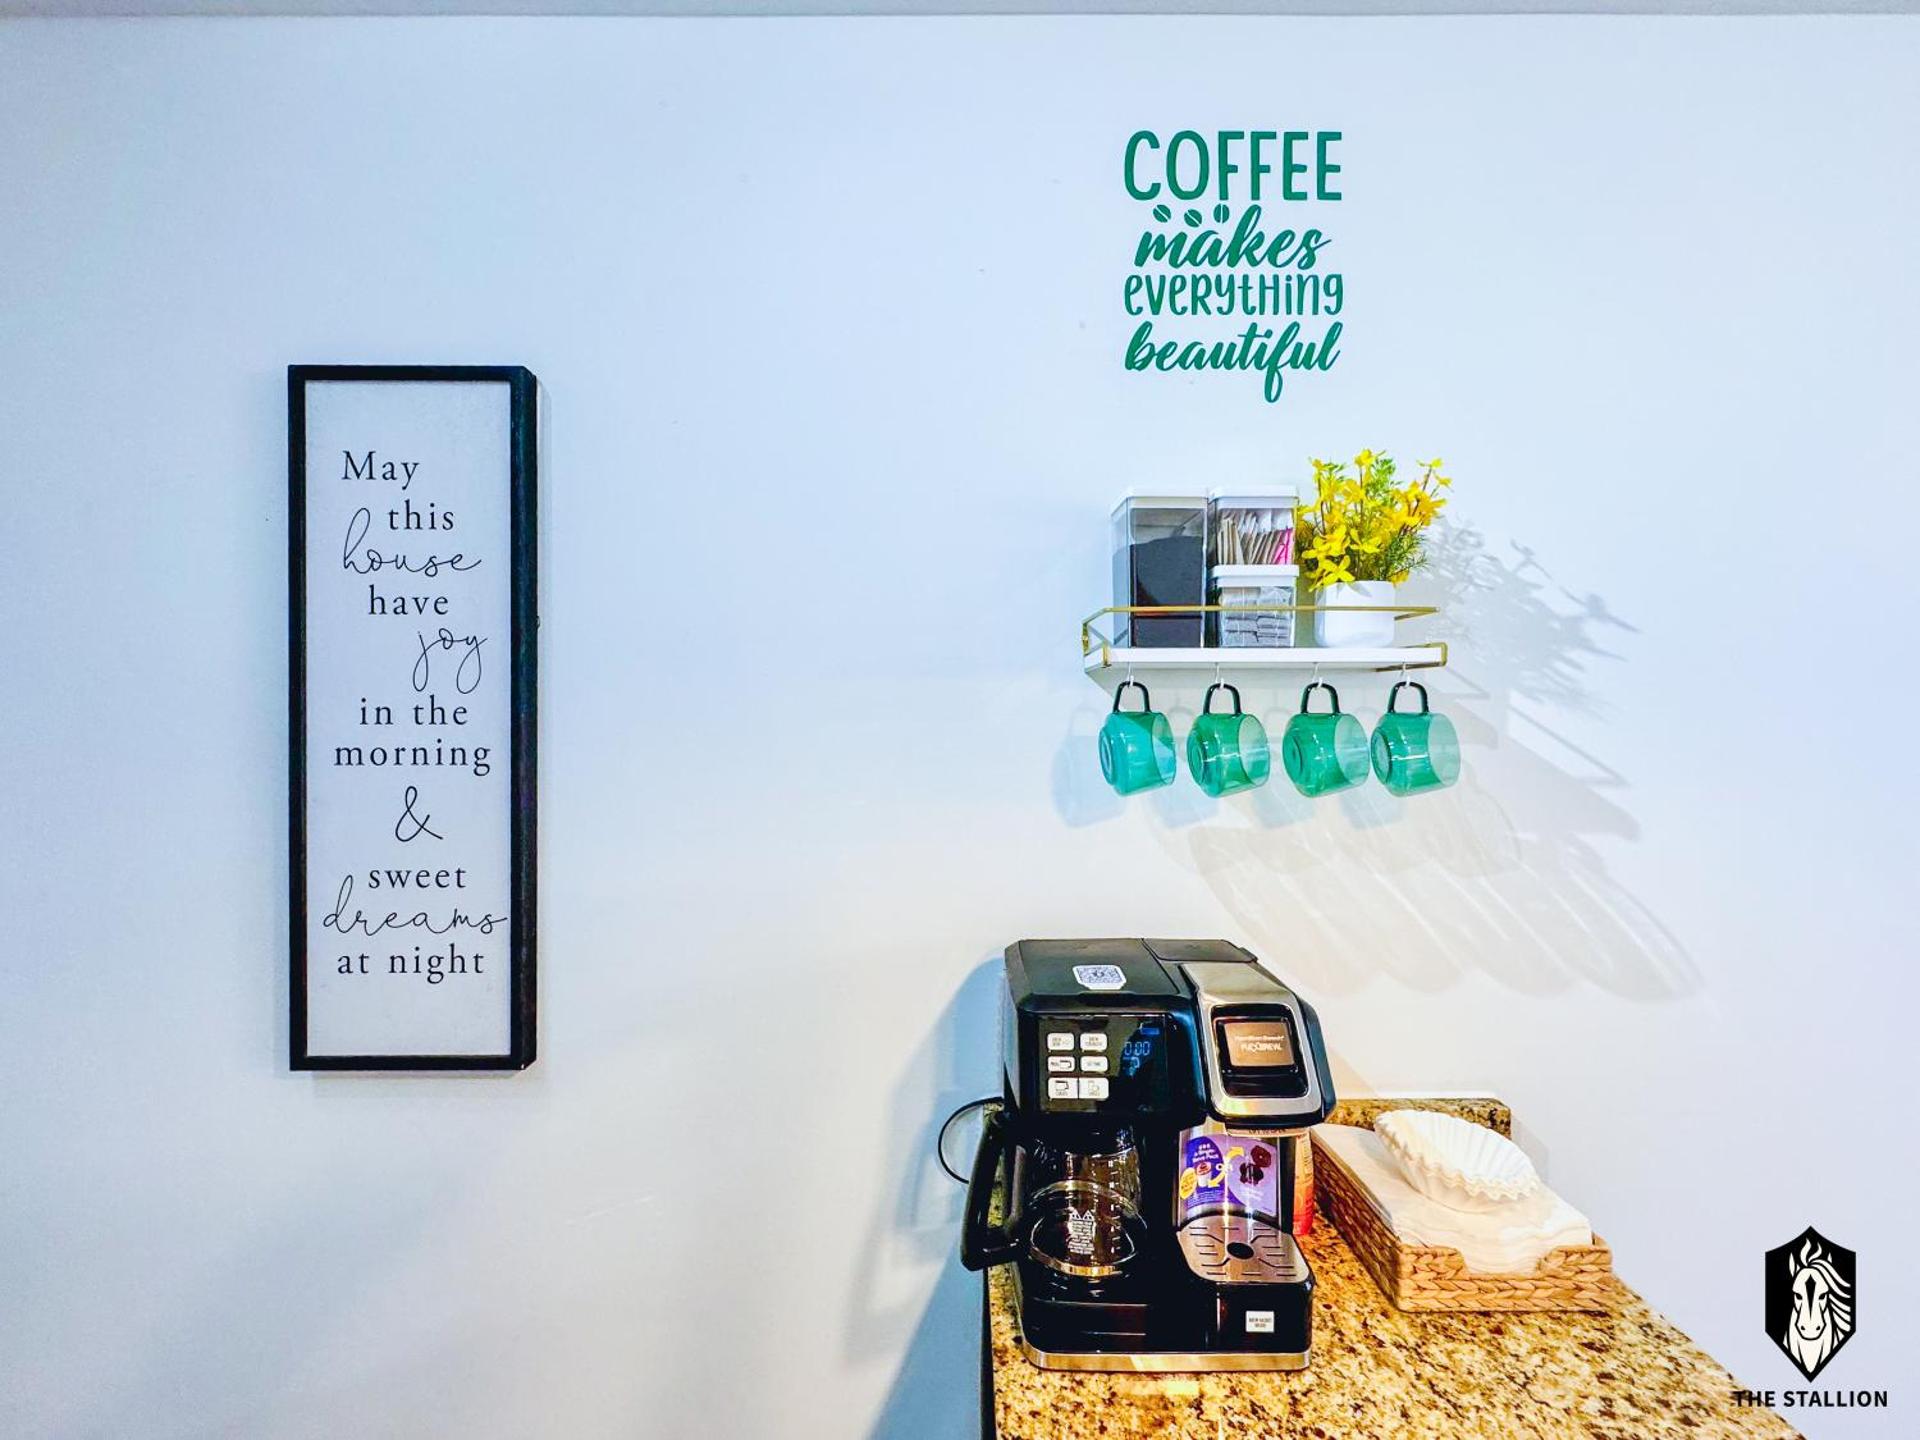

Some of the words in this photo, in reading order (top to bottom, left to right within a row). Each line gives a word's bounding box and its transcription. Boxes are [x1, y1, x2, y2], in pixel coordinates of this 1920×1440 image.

[1124, 130, 1342, 201] COFFEE
[1134, 204, 1332, 270] makes
[1124, 320, 1343, 403] beautiful
[341, 451, 420, 490] May
[388, 500, 454, 531] this
[343, 508, 482, 577] house
[368, 584, 449, 615] have
[413, 628, 487, 694] joy
[360, 697, 393, 725] in
[413, 694, 468, 725] the
[334, 738, 490, 776] morning
[395, 786, 443, 842] &
[368, 868, 467, 889] sweet
[323, 874, 508, 937] dreams
[338, 953, 369, 974] at
[388, 943, 485, 984] night
